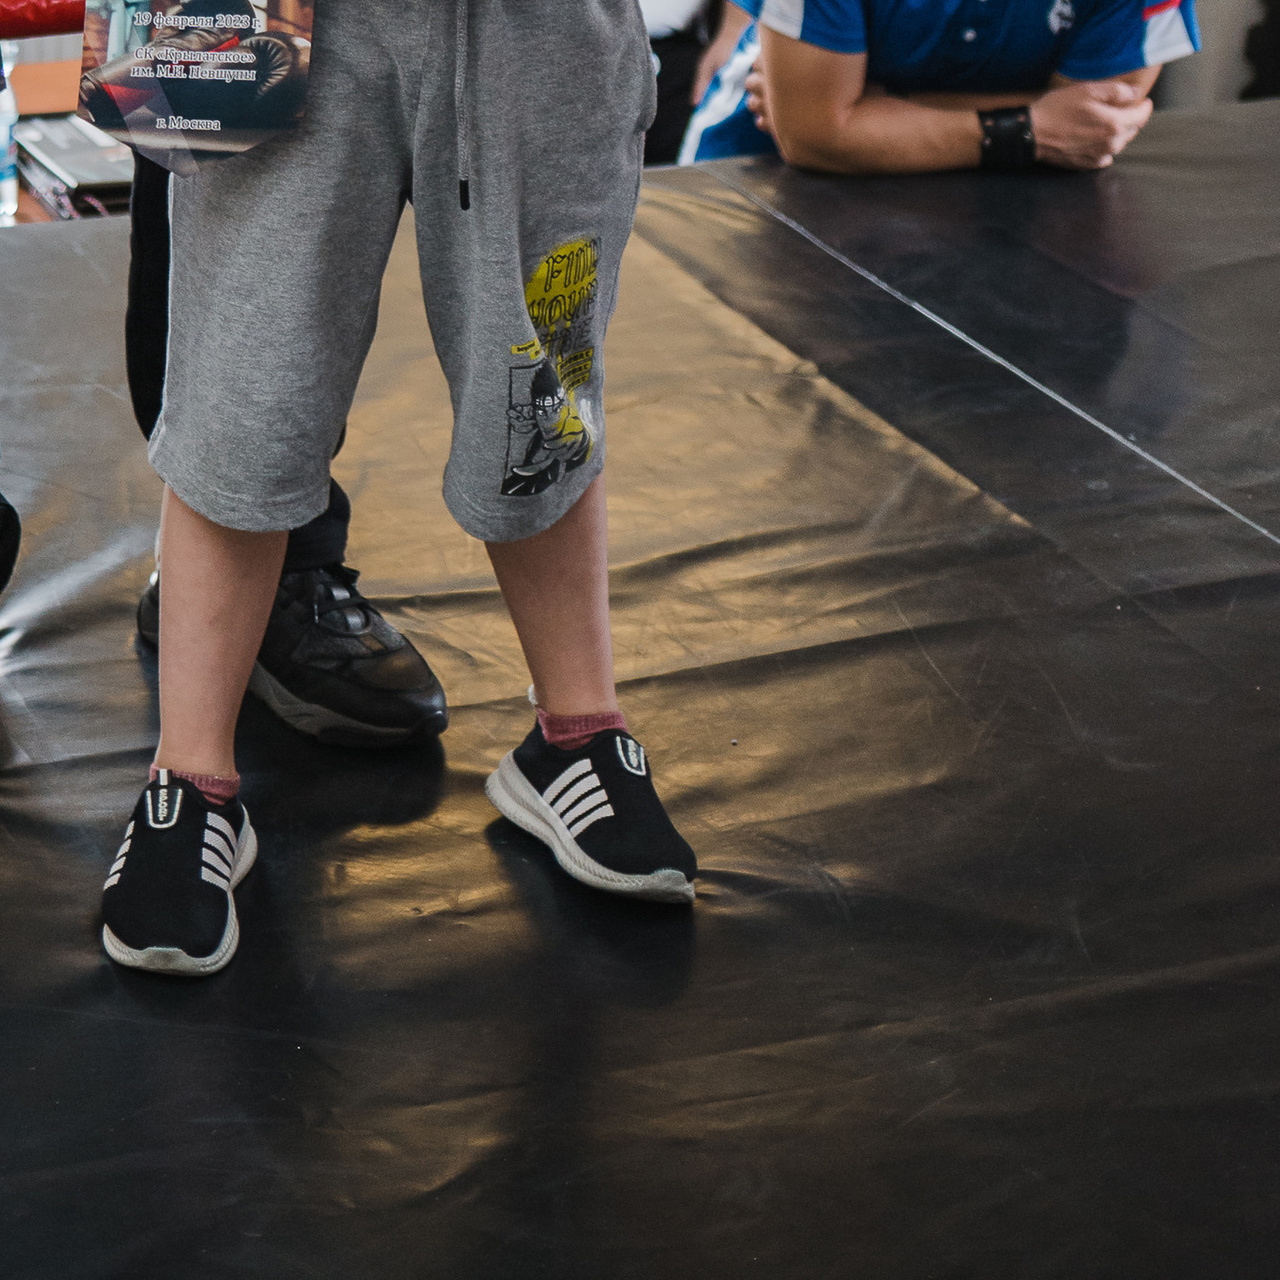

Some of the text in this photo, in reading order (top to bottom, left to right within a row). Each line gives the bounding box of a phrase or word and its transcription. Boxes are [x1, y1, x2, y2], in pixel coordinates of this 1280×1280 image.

[133, 11, 262, 29] 19 февраля 2023 г.
[134, 47, 256, 64] СК «Крылатское»
[130, 66, 155, 78] им.
[156, 115, 221, 131] г. Москва
